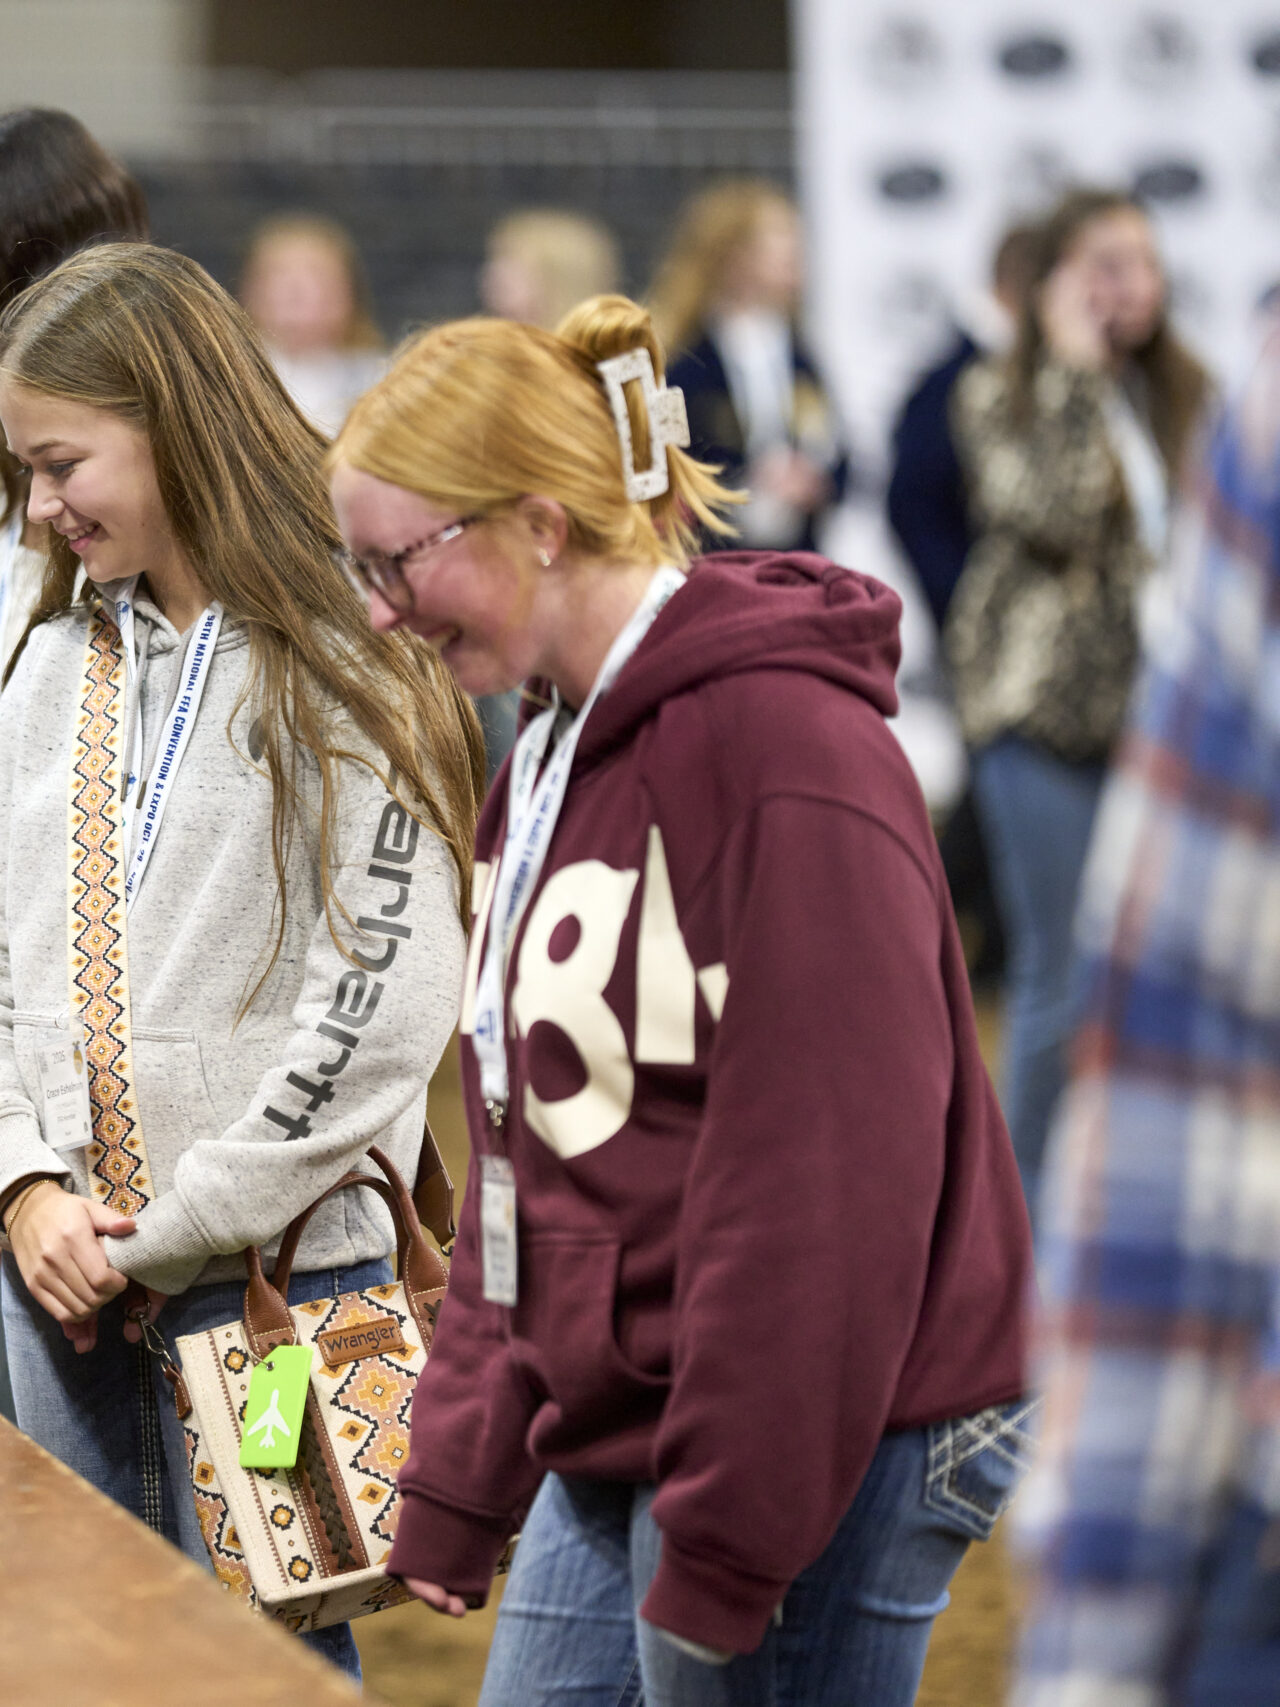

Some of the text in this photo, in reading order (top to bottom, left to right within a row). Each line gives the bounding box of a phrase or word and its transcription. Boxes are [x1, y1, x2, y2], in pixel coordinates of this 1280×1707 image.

[199, 615, 216, 640] 98TH
[186, 643, 207, 691] NATIONAL
[177, 695, 191, 713] FFA
[157, 716, 186, 781] CONVENTION
[155, 782, 165, 790] &
[147, 792, 162, 820] EXPO
[262, 758, 421, 1141] arhartt
[324, 1326, 395, 1352] Wrangler
